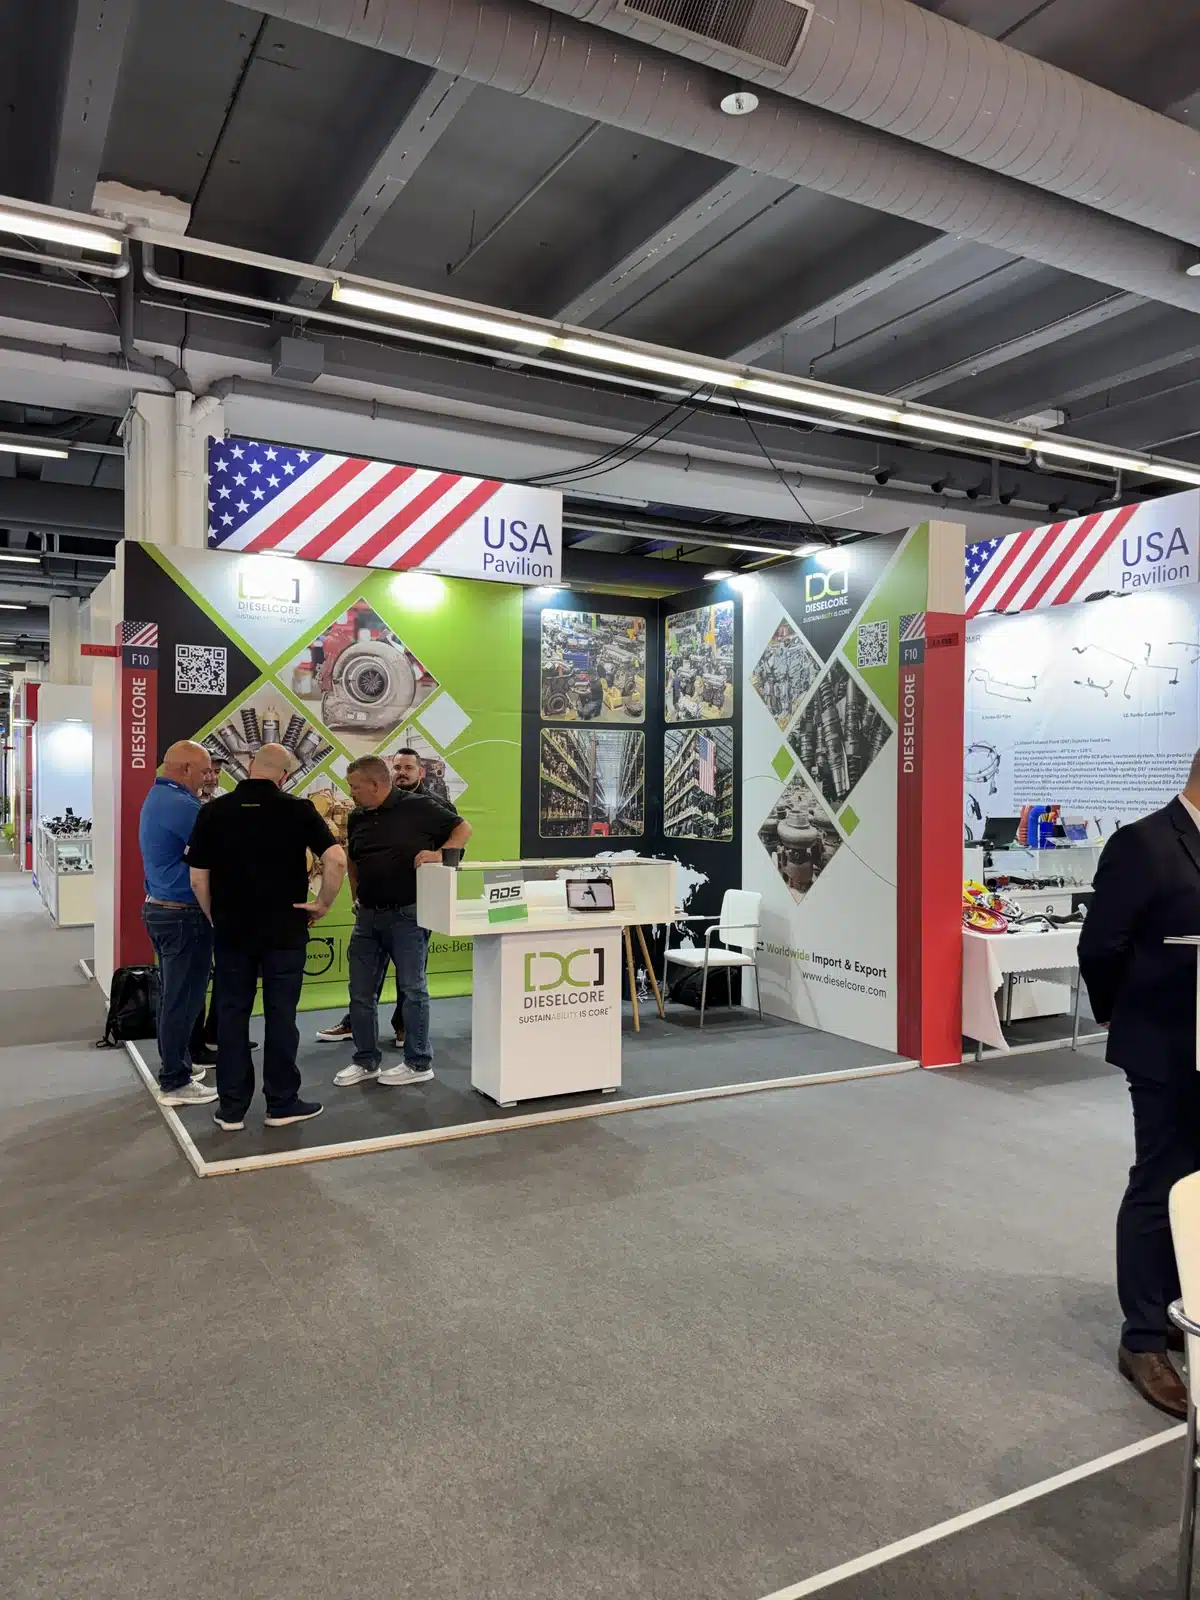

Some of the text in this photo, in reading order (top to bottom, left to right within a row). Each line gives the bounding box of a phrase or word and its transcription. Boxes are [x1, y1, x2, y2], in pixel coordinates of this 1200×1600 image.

[484, 516, 553, 556] USA
[1121, 527, 1190, 567] USA
[483, 552, 553, 578] Pavilion
[1121, 564, 1190, 588] Pavilion
[238, 601, 301, 615] DIESELCORE
[805, 596, 849, 613] DIESELCORE
[131, 653, 150, 666] F10
[904, 648, 918, 661] F10
[131, 676, 147, 769] DIESELCORE
[903, 673, 916, 773] DIESELCORE
[489, 885, 521, 900] ADS
[766, 942, 887, 978] Worldwide Import & Export
[802, 971, 887, 998] www.dieselcore.com
[523, 990, 605, 1009] DIESELCORE
[518, 1011, 578, 1024] SUSTAINABILITY
[579, 1009, 587, 1018] IS
